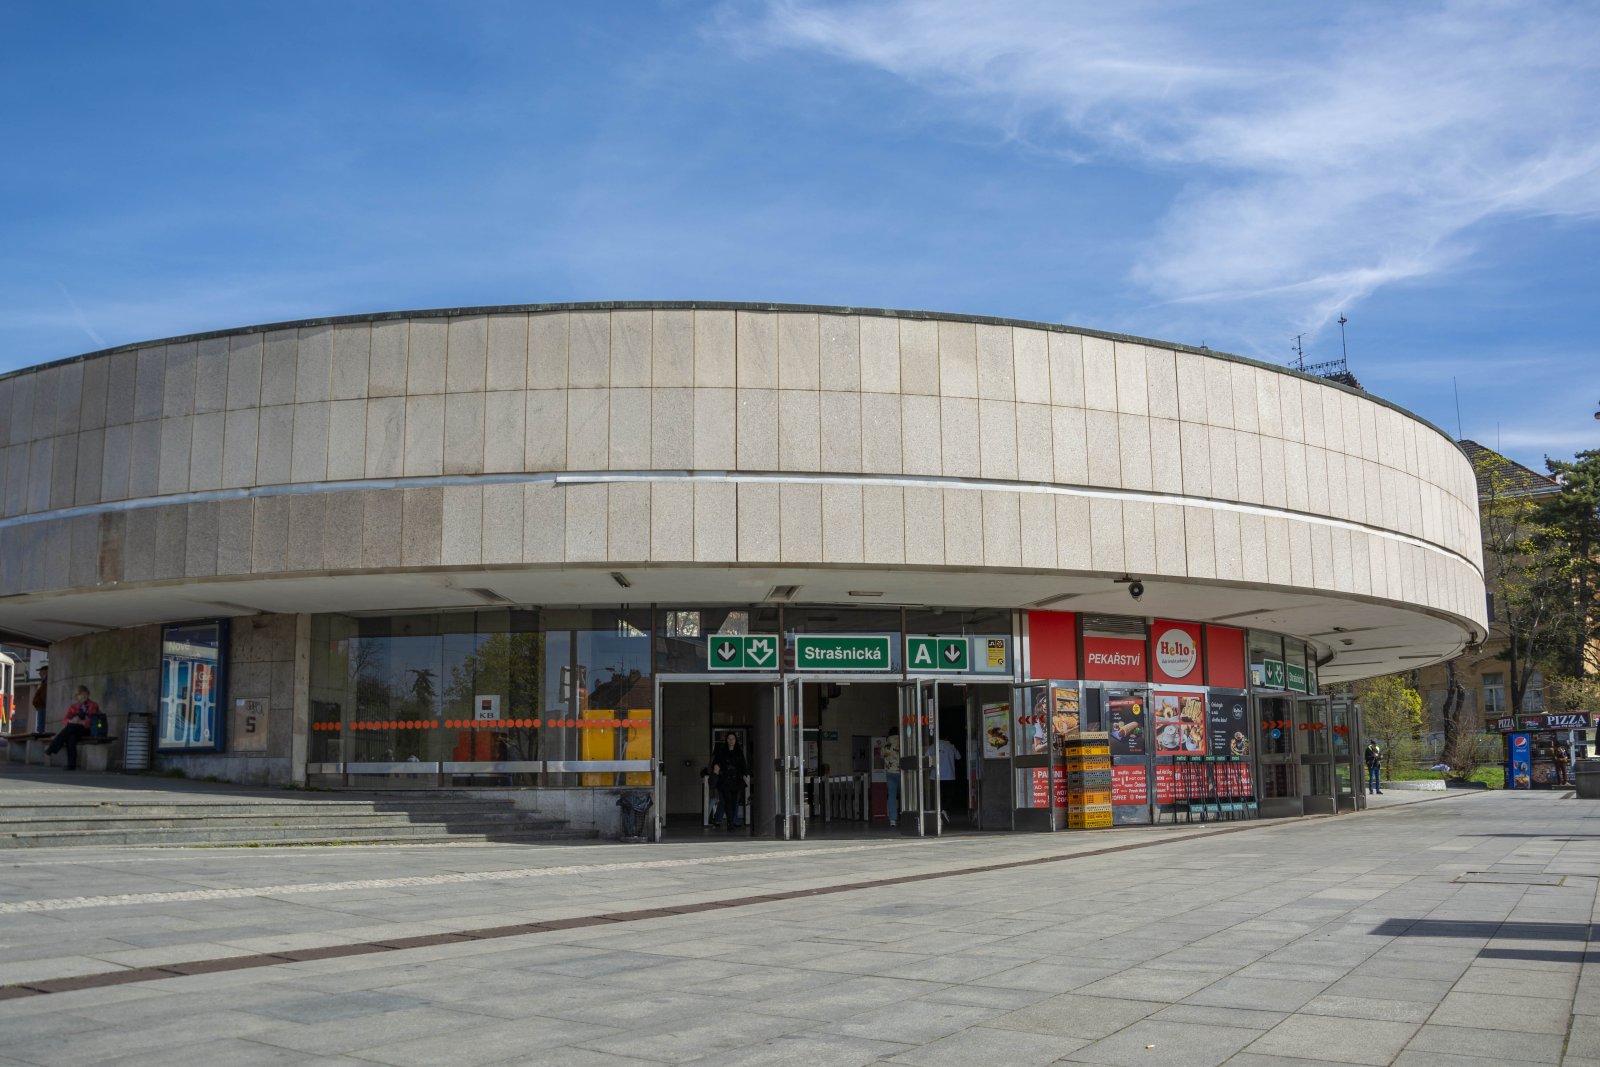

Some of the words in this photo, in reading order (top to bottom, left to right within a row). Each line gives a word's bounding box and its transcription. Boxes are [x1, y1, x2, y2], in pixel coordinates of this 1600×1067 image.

[804, 646, 881, 660] Strašnická
[914, 643, 932, 664] A
[1088, 652, 1140, 666] PEKAŘSTVÍ
[1498, 719, 1515, 729] PIZZA
[1547, 715, 1587, 725] PIZZA
